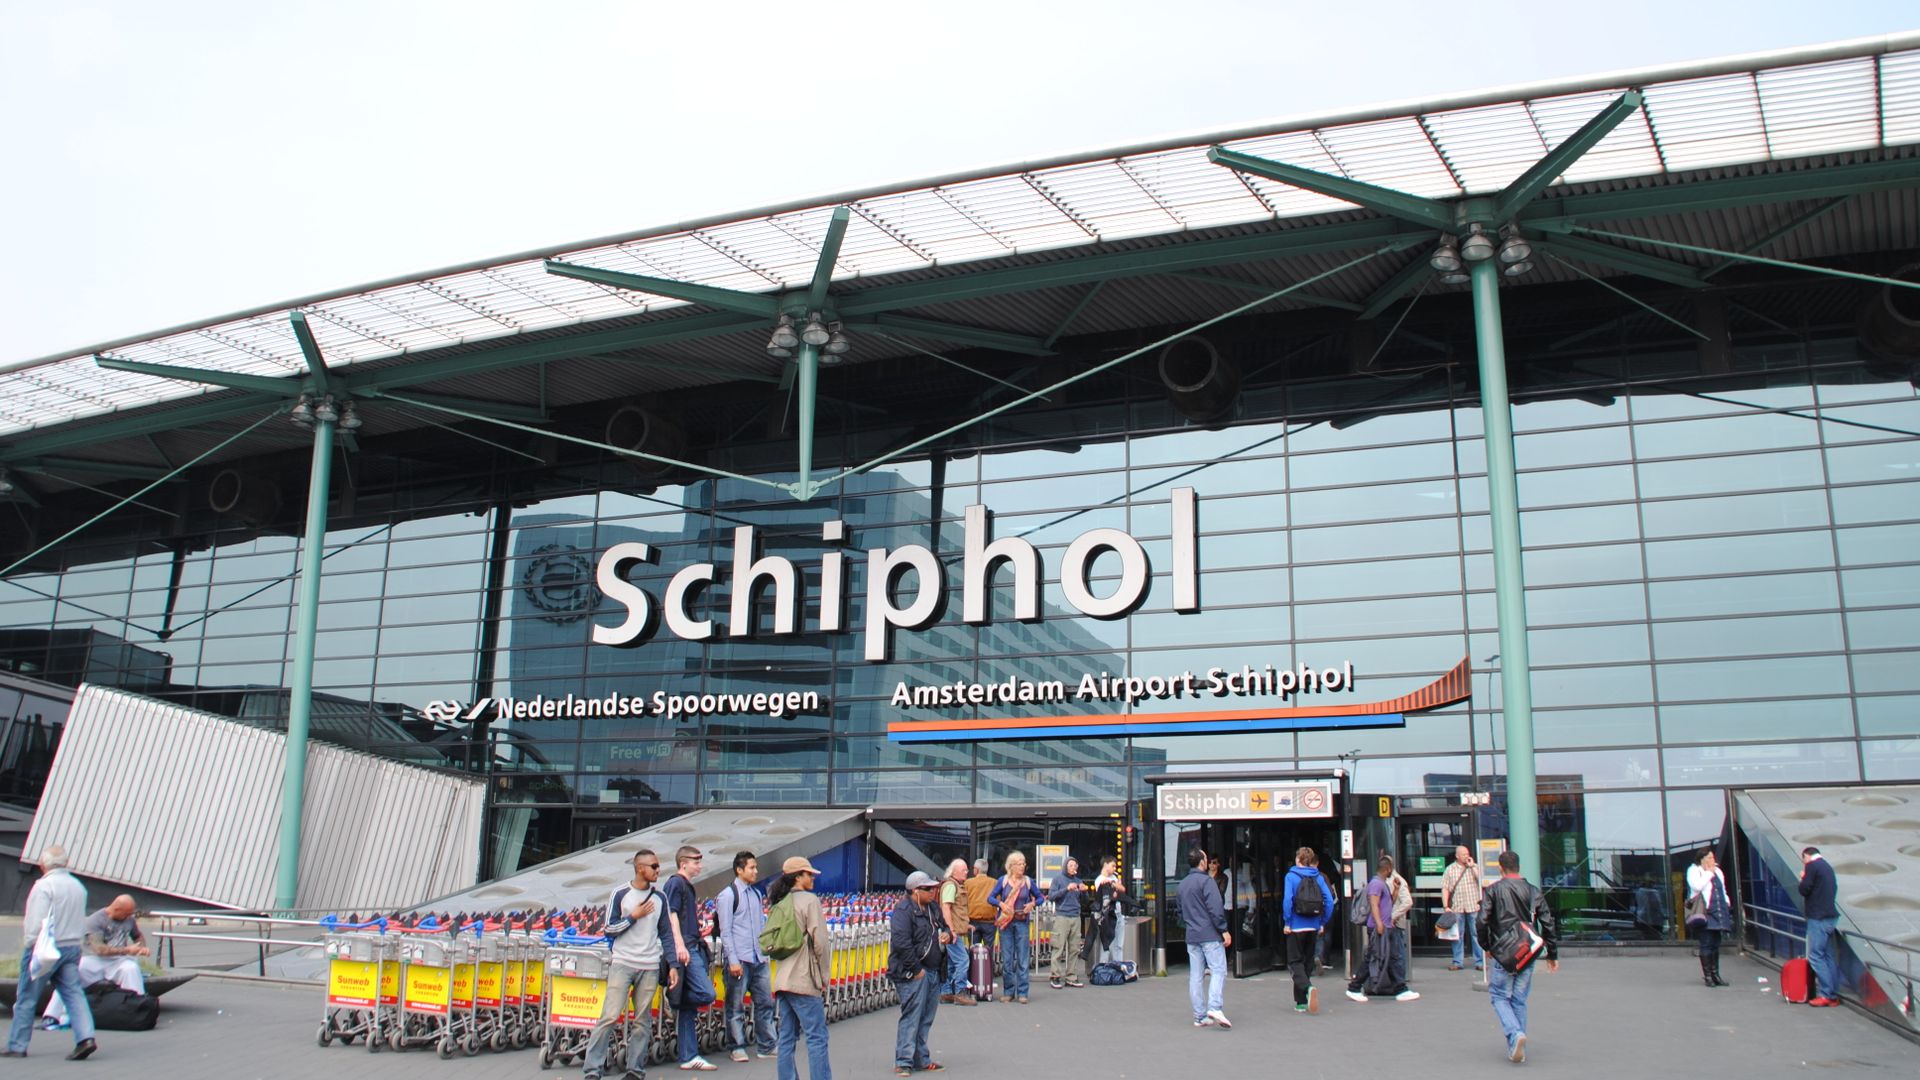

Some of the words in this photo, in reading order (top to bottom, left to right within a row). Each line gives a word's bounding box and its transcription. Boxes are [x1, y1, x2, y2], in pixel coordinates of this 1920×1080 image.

[592, 486, 1200, 662] Schiphol
[890, 675, 1064, 706] Amsterdam
[1076, 670, 1194, 705] Airport
[1207, 659, 1352, 698] Schiphol
[498, 691, 645, 720] Nederlandse
[652, 690, 819, 720] Spoorwegen
[610, 745, 642, 760] Free
[1163, 792, 1246, 813] Schiphol
[1381, 800, 1388, 814] D
[337, 975, 370, 986] Sunweb
[413, 980, 443, 992] Sunweb
[560, 992, 598, 1005] Sunweb
